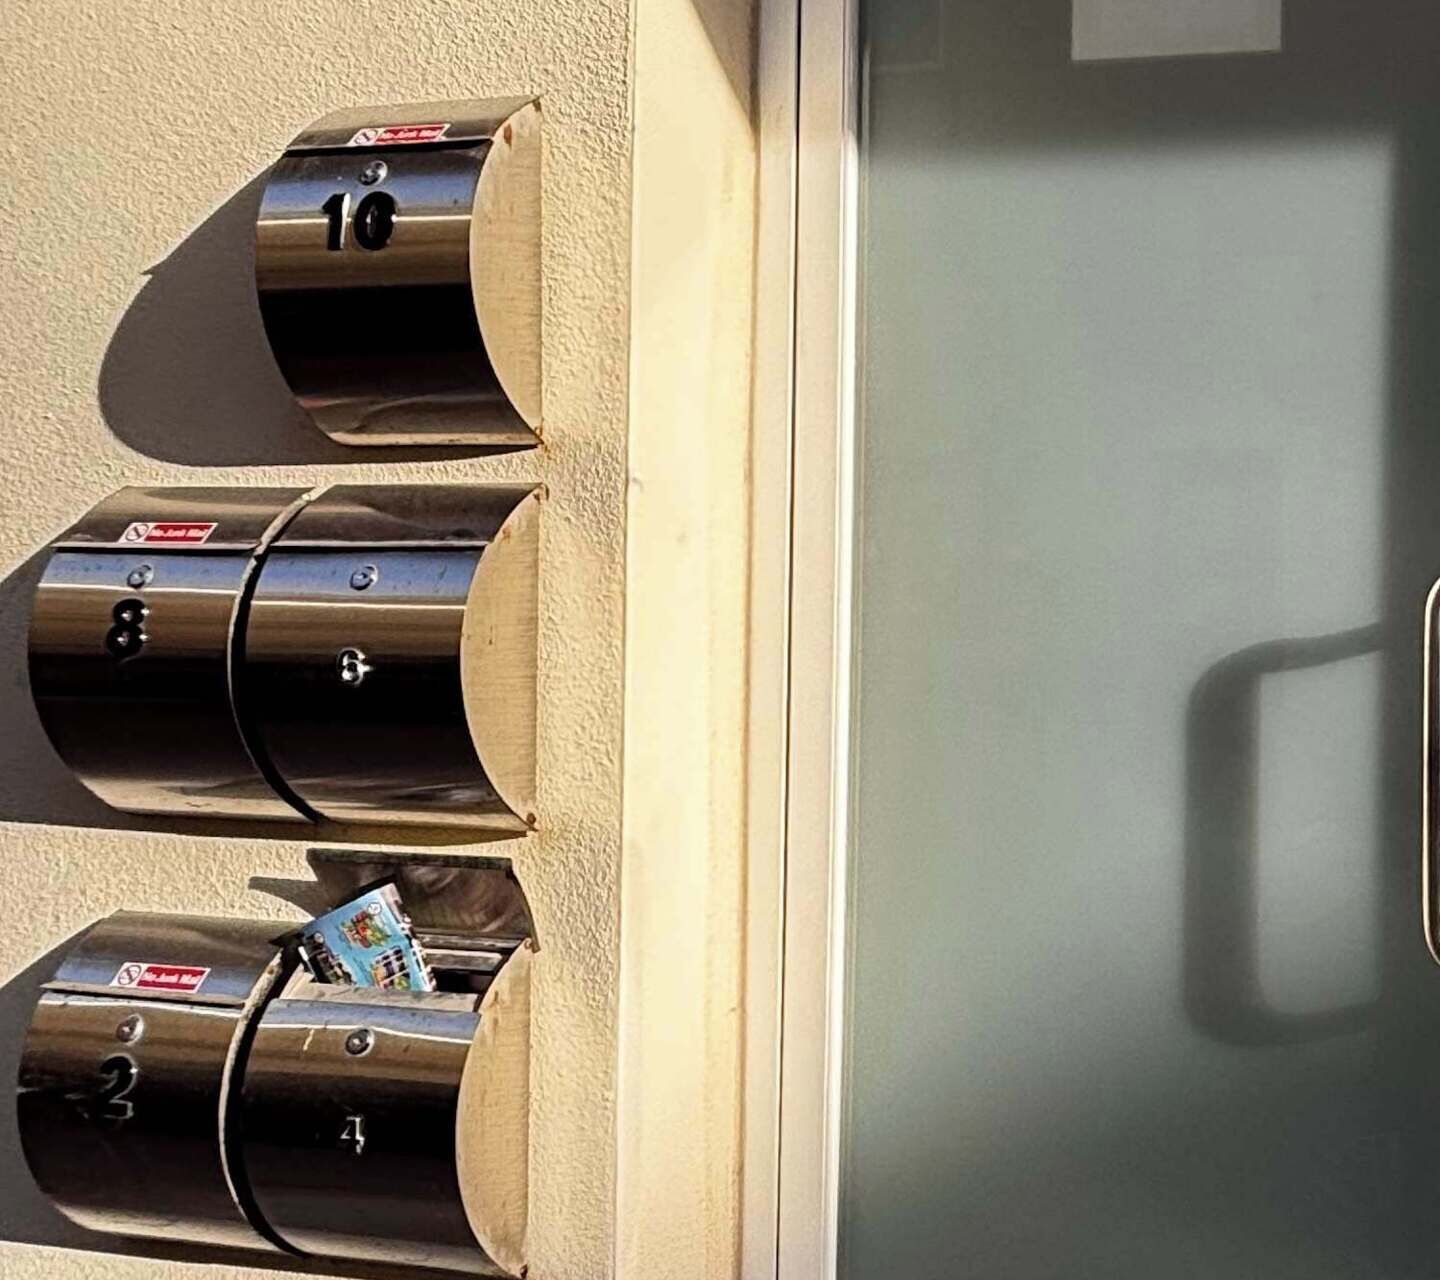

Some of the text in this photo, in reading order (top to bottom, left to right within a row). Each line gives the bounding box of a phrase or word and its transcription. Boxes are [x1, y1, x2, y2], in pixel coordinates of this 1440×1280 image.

[322, 191, 397, 251] 10
[106, 598, 148, 658] 8
[98, 1052, 138, 1120] 2
[339, 1112, 368, 1156] 4
